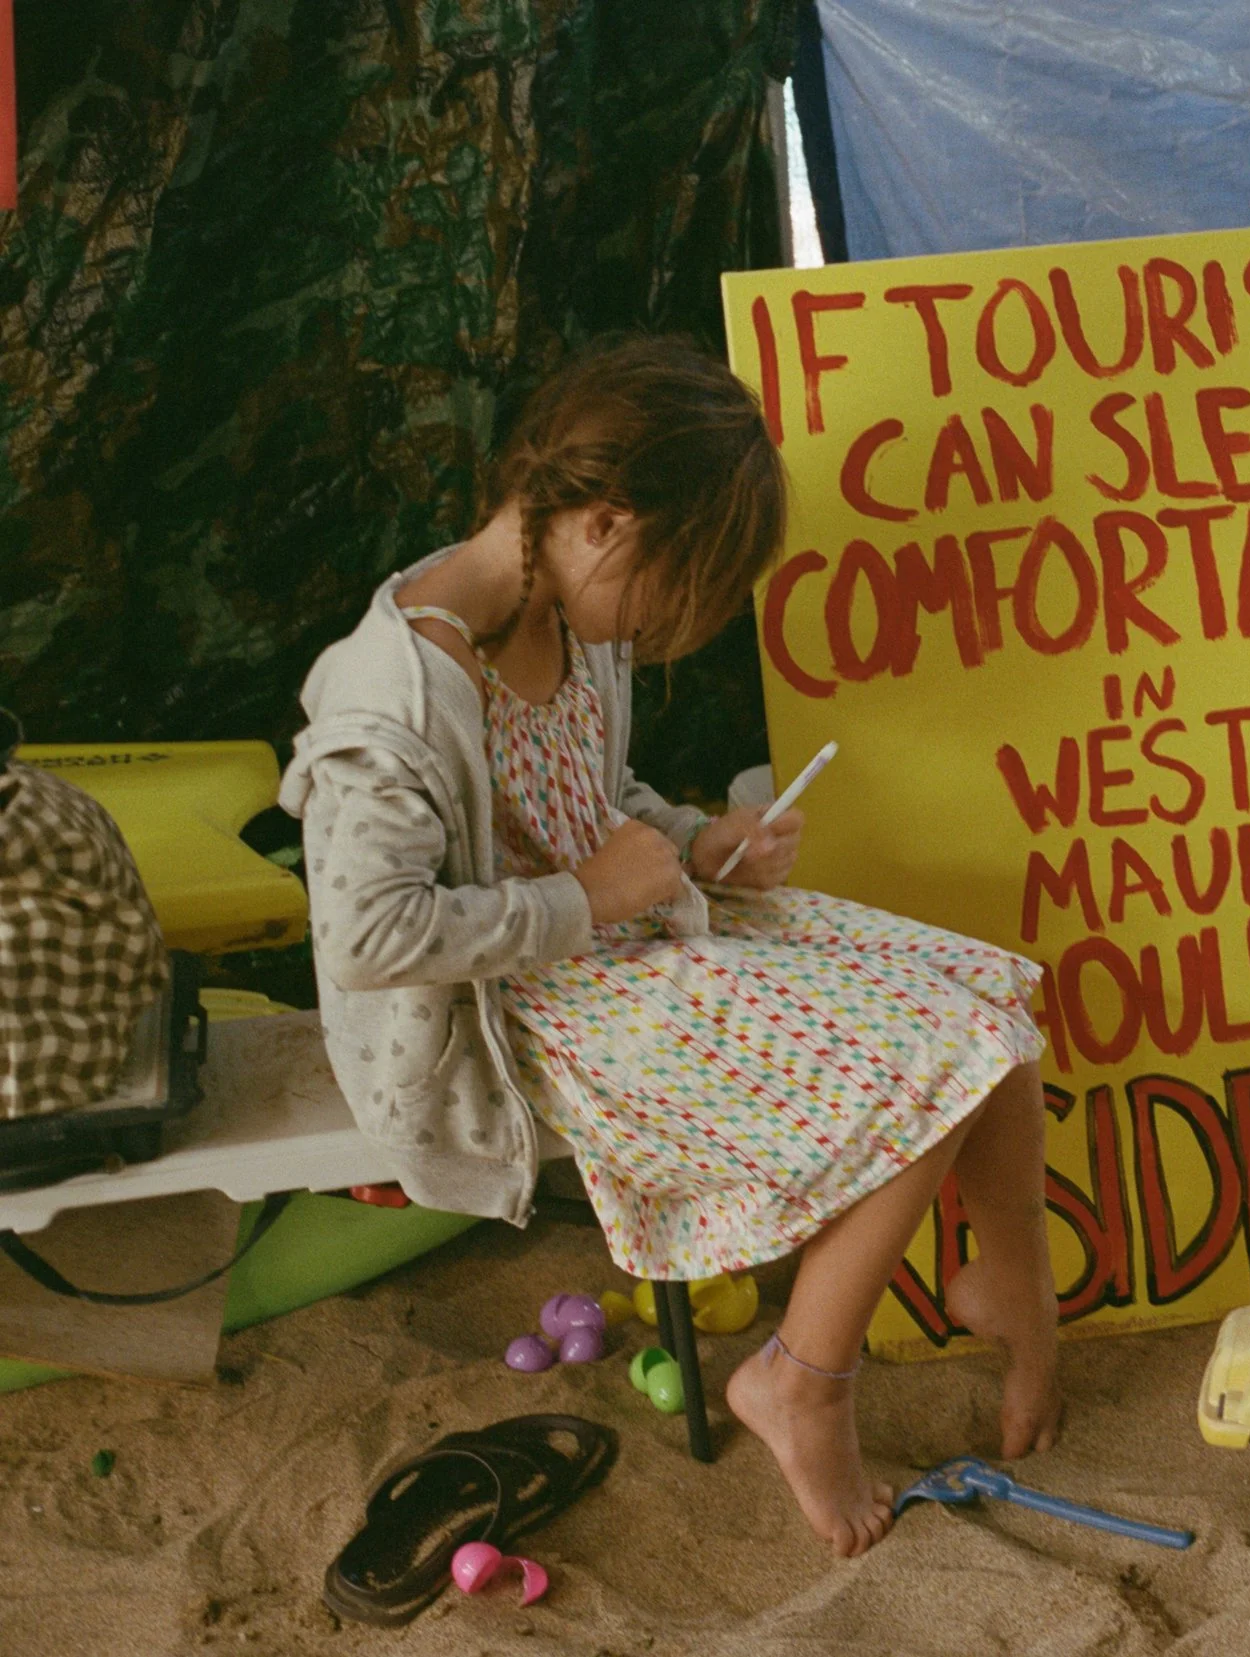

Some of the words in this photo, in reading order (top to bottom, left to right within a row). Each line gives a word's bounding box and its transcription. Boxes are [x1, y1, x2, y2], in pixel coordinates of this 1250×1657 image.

[751, 290, 865, 447] IF
[839, 402, 1054, 521] CAN
[1103, 666, 1177, 720] IN
